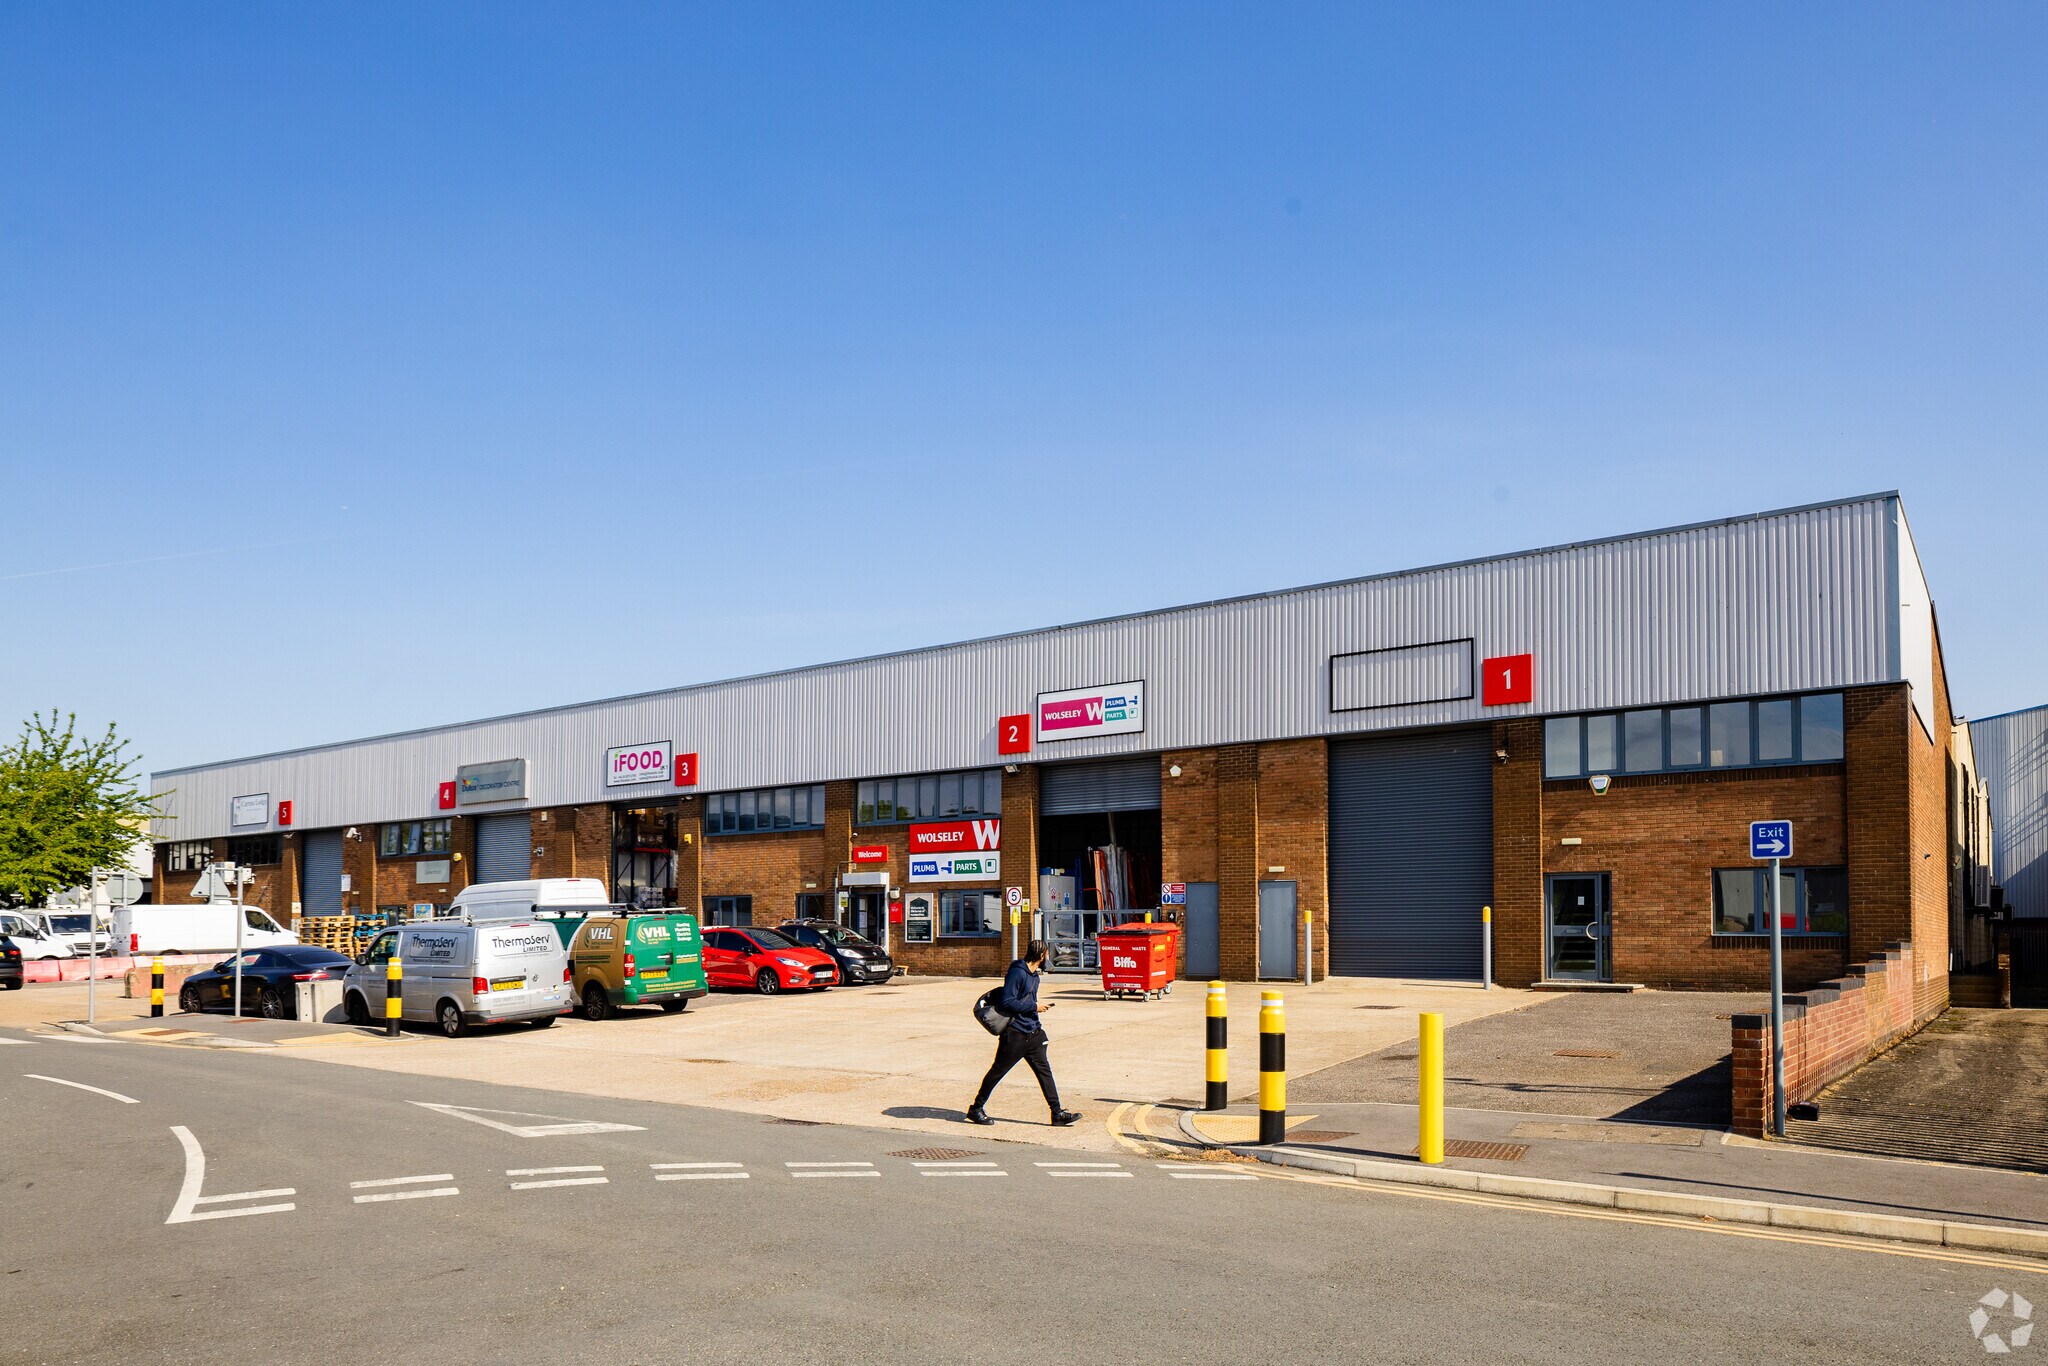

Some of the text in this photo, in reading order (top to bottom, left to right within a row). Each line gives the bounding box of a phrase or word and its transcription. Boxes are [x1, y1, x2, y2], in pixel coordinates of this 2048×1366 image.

[1503, 669, 1511, 690] 1
[1045, 702, 1103, 721] WOLSELEY W
[1008, 725, 1018, 742] 2
[614, 750, 662, 772] iFOOD
[682, 762, 688, 776] 3
[504, 779, 520, 787] CENTRE
[443, 789, 449, 800] 4
[282, 808, 287, 818] 5
[917, 820, 1000, 850] WOLSELEY W
[1759, 827, 1783, 838] Exit
[913, 863, 977, 872] PLUMB PARTS
[1012, 892, 1017, 901] 5
[591, 928, 613, 940] VHL
[643, 926, 670, 937] VHL
[412, 934, 458, 948] ThermoServ
[492, 935, 550, 948] ThermoServ
[1114, 956, 1136, 968] Biffa
